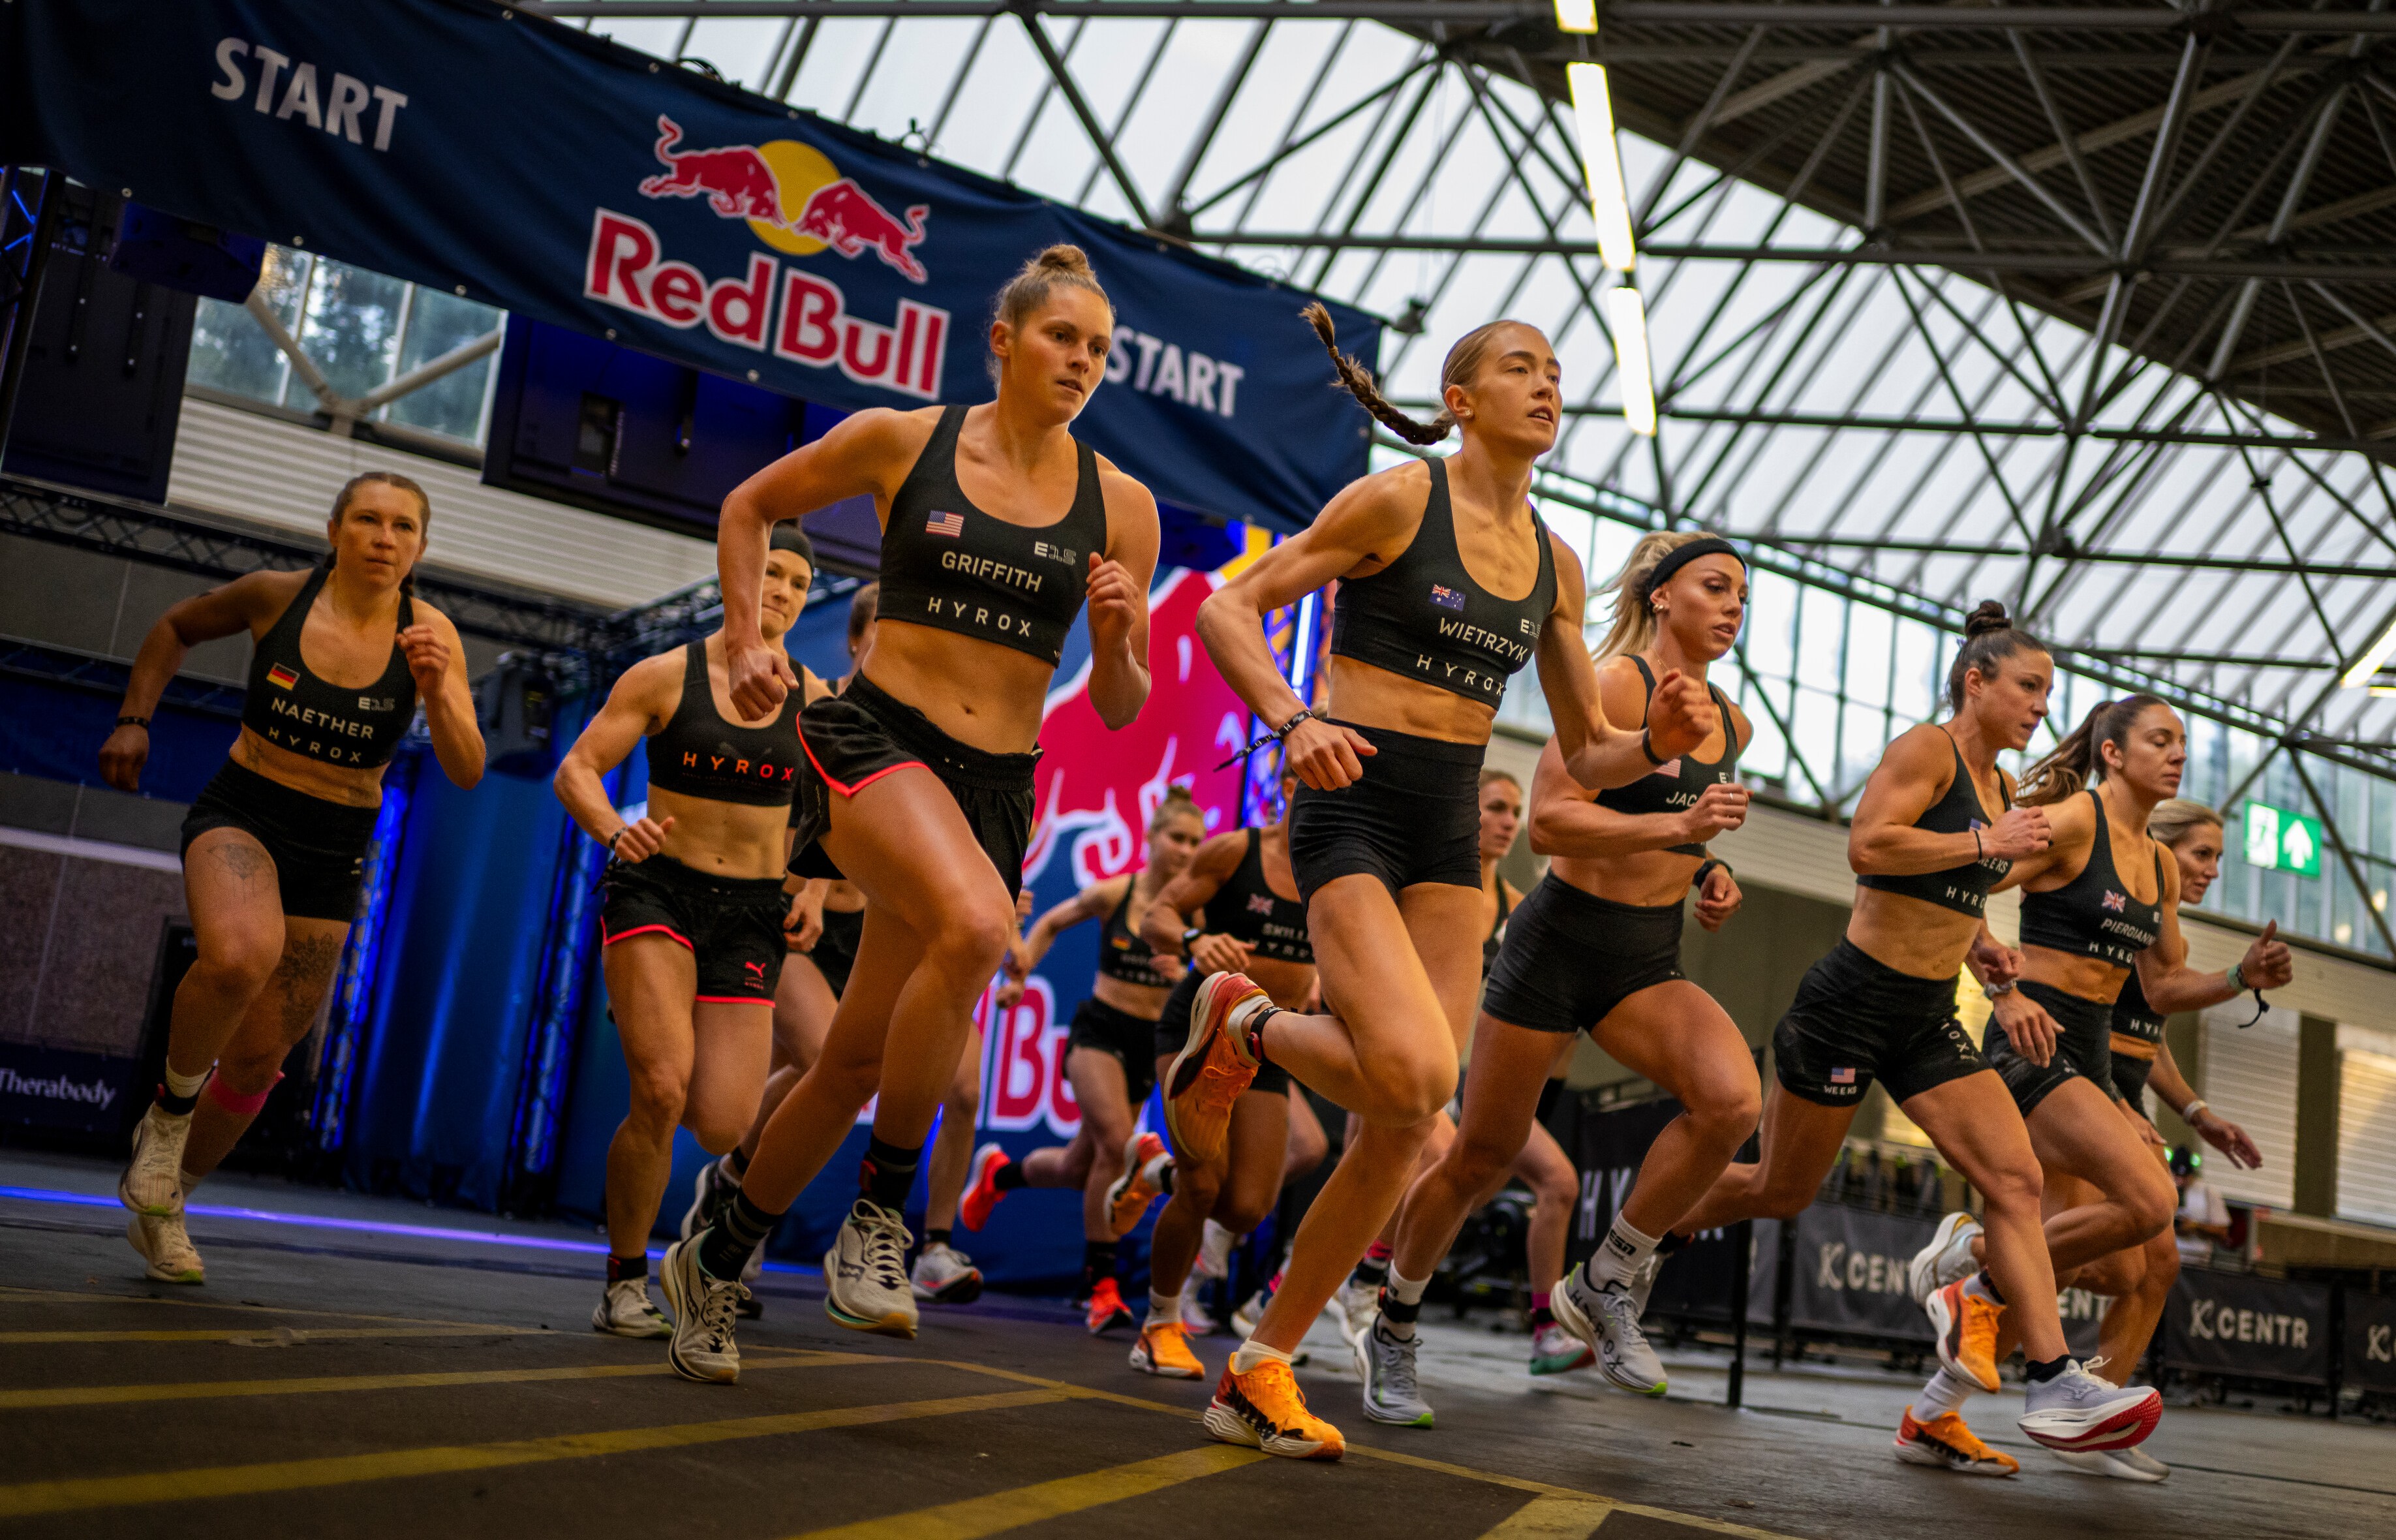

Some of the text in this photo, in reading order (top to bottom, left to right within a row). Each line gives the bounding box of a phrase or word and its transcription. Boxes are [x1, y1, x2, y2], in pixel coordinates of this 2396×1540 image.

[211, 37, 408, 152] START
[583, 207, 951, 401] Red Bull
[1105, 325, 1244, 418] START
[942, 551, 1042, 593] GRIFFITH
[927, 596, 1032, 638] HYROX
[1438, 617, 1529, 663] WIETRZYK
[270, 696, 375, 740] NAETHER
[268, 726, 362, 763] HYROX
[683, 750, 794, 782] HYROX
[988, 976, 1083, 1139] Bu
[0, 1068, 117, 1111] Therabody
